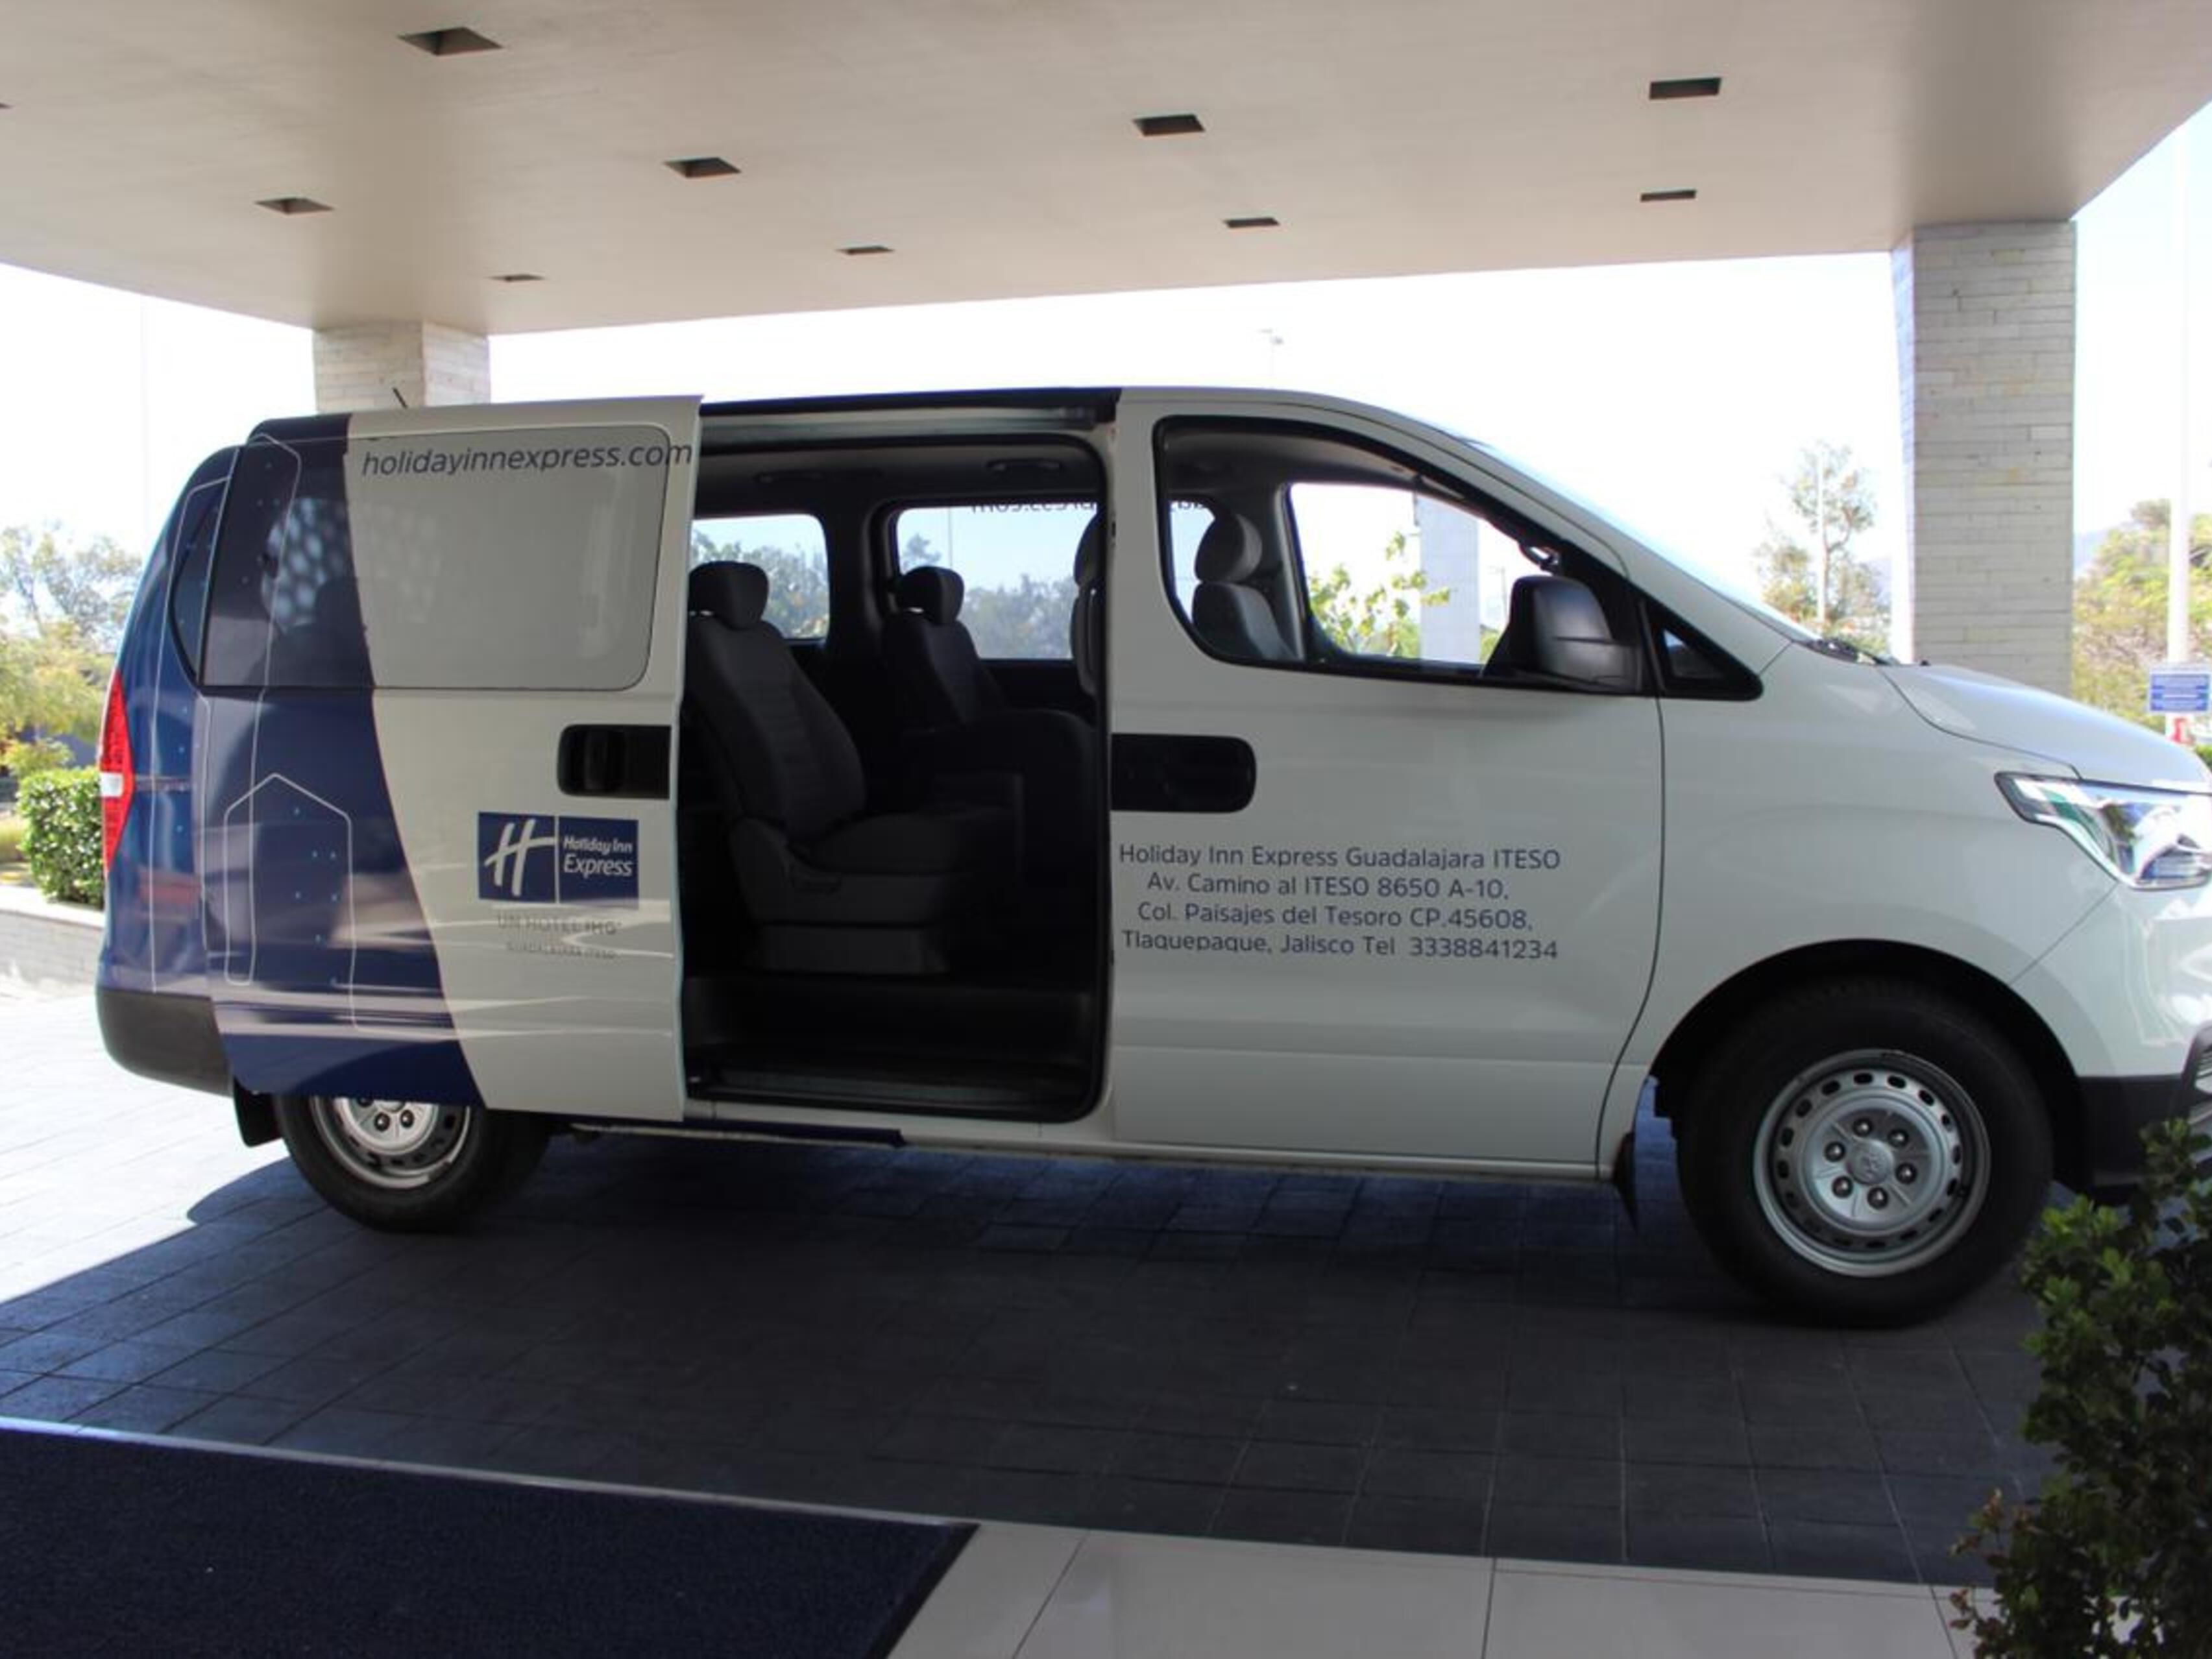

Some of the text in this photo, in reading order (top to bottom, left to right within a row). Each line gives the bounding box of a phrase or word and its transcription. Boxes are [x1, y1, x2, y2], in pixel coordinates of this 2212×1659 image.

[361, 444, 692, 475] holidayinnexpress.com
[563, 835, 633, 854] Holiday Inn
[563, 854, 633, 878] Express
[1120, 845, 1561, 871] Holiday Inn Express Guadalajara ITESO
[1147, 873, 1179, 893] Av.
[1187, 874, 1270, 895] Camino
[1278, 876, 1296, 895] al
[1304, 877, 1370, 898] ITESO
[1377, 877, 1440, 899] 8650
[1137, 902, 1176, 921] Col.
[1185, 902, 1275, 926] Paisajes
[1282, 904, 1318, 925] del
[1326, 905, 1402, 927] Tesoro
[1122, 930, 1559, 959] Tlaquepaque, Jalisco Tel 3338841234
